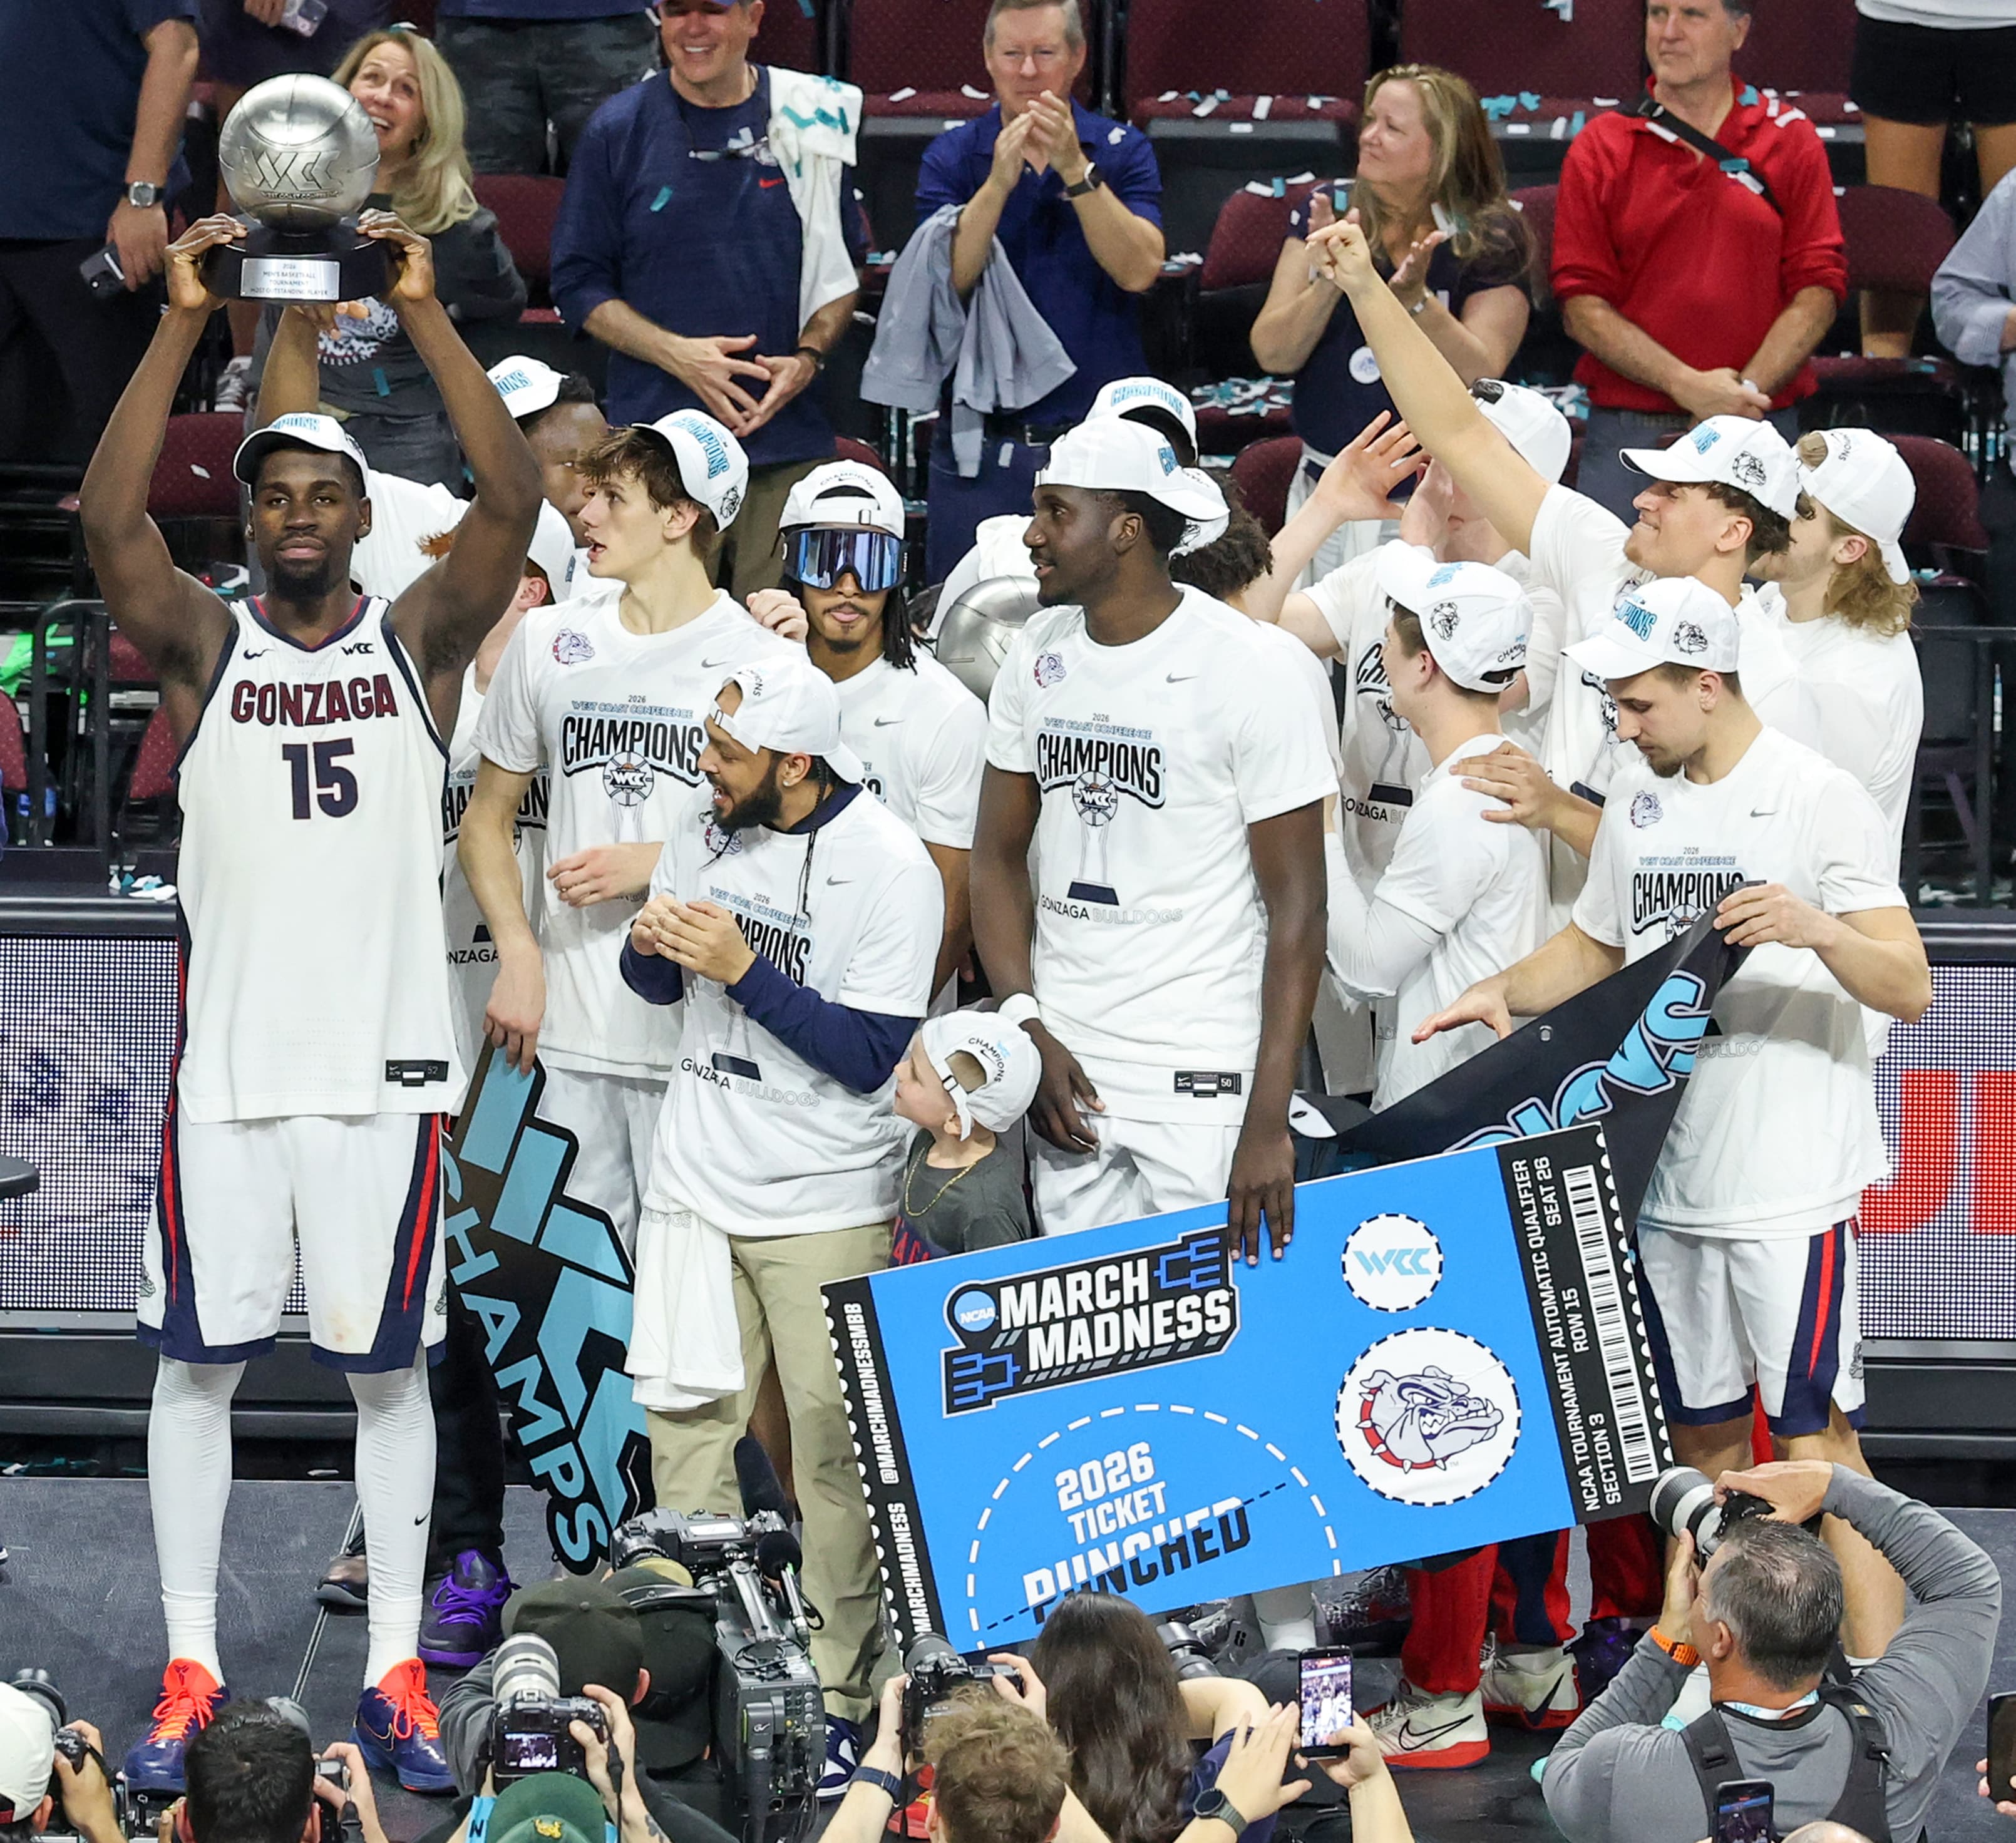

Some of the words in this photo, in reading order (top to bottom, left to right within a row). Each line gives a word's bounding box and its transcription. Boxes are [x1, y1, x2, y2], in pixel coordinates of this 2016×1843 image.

[1110, 384, 1184, 419] CHAMPIONS
[341, 643, 374, 655] WCC
[231, 674, 399, 727] GONZAGA
[571, 701, 598, 711] WEST
[599, 702, 629, 713] COAST
[630, 705, 694, 719] CONFERENCE
[628, 695, 646, 703] 2026
[1093, 713, 1110, 722] 2026
[563, 716, 704, 776] CHAMPIONS
[1044, 717, 1066, 727] WEST
[1066, 720, 1094, 732] COAST
[1095, 723, 1153, 740] CONFERENCE
[282, 737, 359, 820] 15
[611, 771, 647, 786] WCC
[1037, 732, 1161, 799] CHAMPIONS
[1080, 789, 1112, 807] WCC
[753, 893, 771, 905] 2026
[1041, 894, 1089, 921] GONZAGA
[1092, 908, 1183, 925] BULLDOGS
[968, 1037, 1005, 1082] CHAMPIONS
[734, 1079, 821, 1107] BULLDOGS
[1221, 1077, 1232, 1087] 50
[1534, 1156, 1553, 1181] 26
[1512, 1159, 1545, 1250] QUALIFIER
[1539, 1184, 1563, 1227] SEAT
[1352, 1248, 1432, 1276] WCC
[1000, 1257, 1150, 1331] MARCH
[1531, 1251, 1566, 1348] AUTOMATIC
[1561, 1287, 1581, 1310] 15
[960, 1307, 995, 1325] NCAA
[1027, 1288, 1232, 1372] MADNESS
[1566, 1312, 1590, 1353] ROW
[844, 1301, 900, 1485] @MARCHMADNESSMBB
[1552, 1352, 1590, 1466] TOURNAMENT
[1588, 1412, 1605, 1427] 3
[1054, 1441, 1156, 1512] 2026
[1592, 1428, 1622, 1505] SECTION
[1575, 1465, 1601, 1511] NCAA
[1067, 1481, 1167, 1545] TICKET
[1022, 1496, 1252, 1626] PUNCHED
